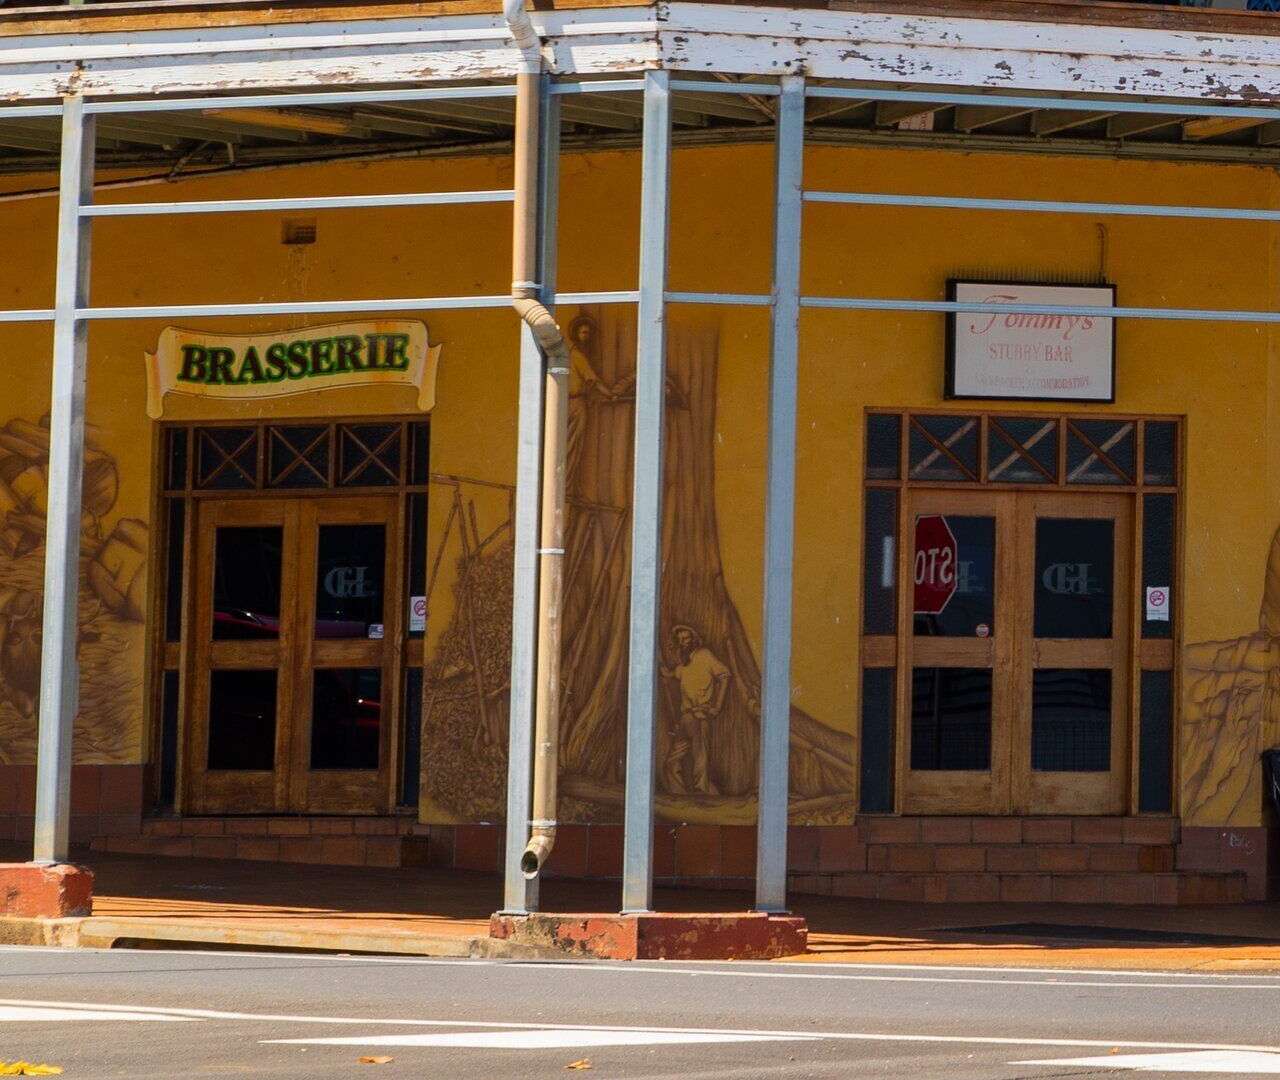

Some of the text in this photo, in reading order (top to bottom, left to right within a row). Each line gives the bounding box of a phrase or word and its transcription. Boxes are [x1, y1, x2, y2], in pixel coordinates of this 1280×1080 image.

[177, 333, 411, 386] BRASSERIE
[989, 343, 1073, 363] STUBBY BAR
